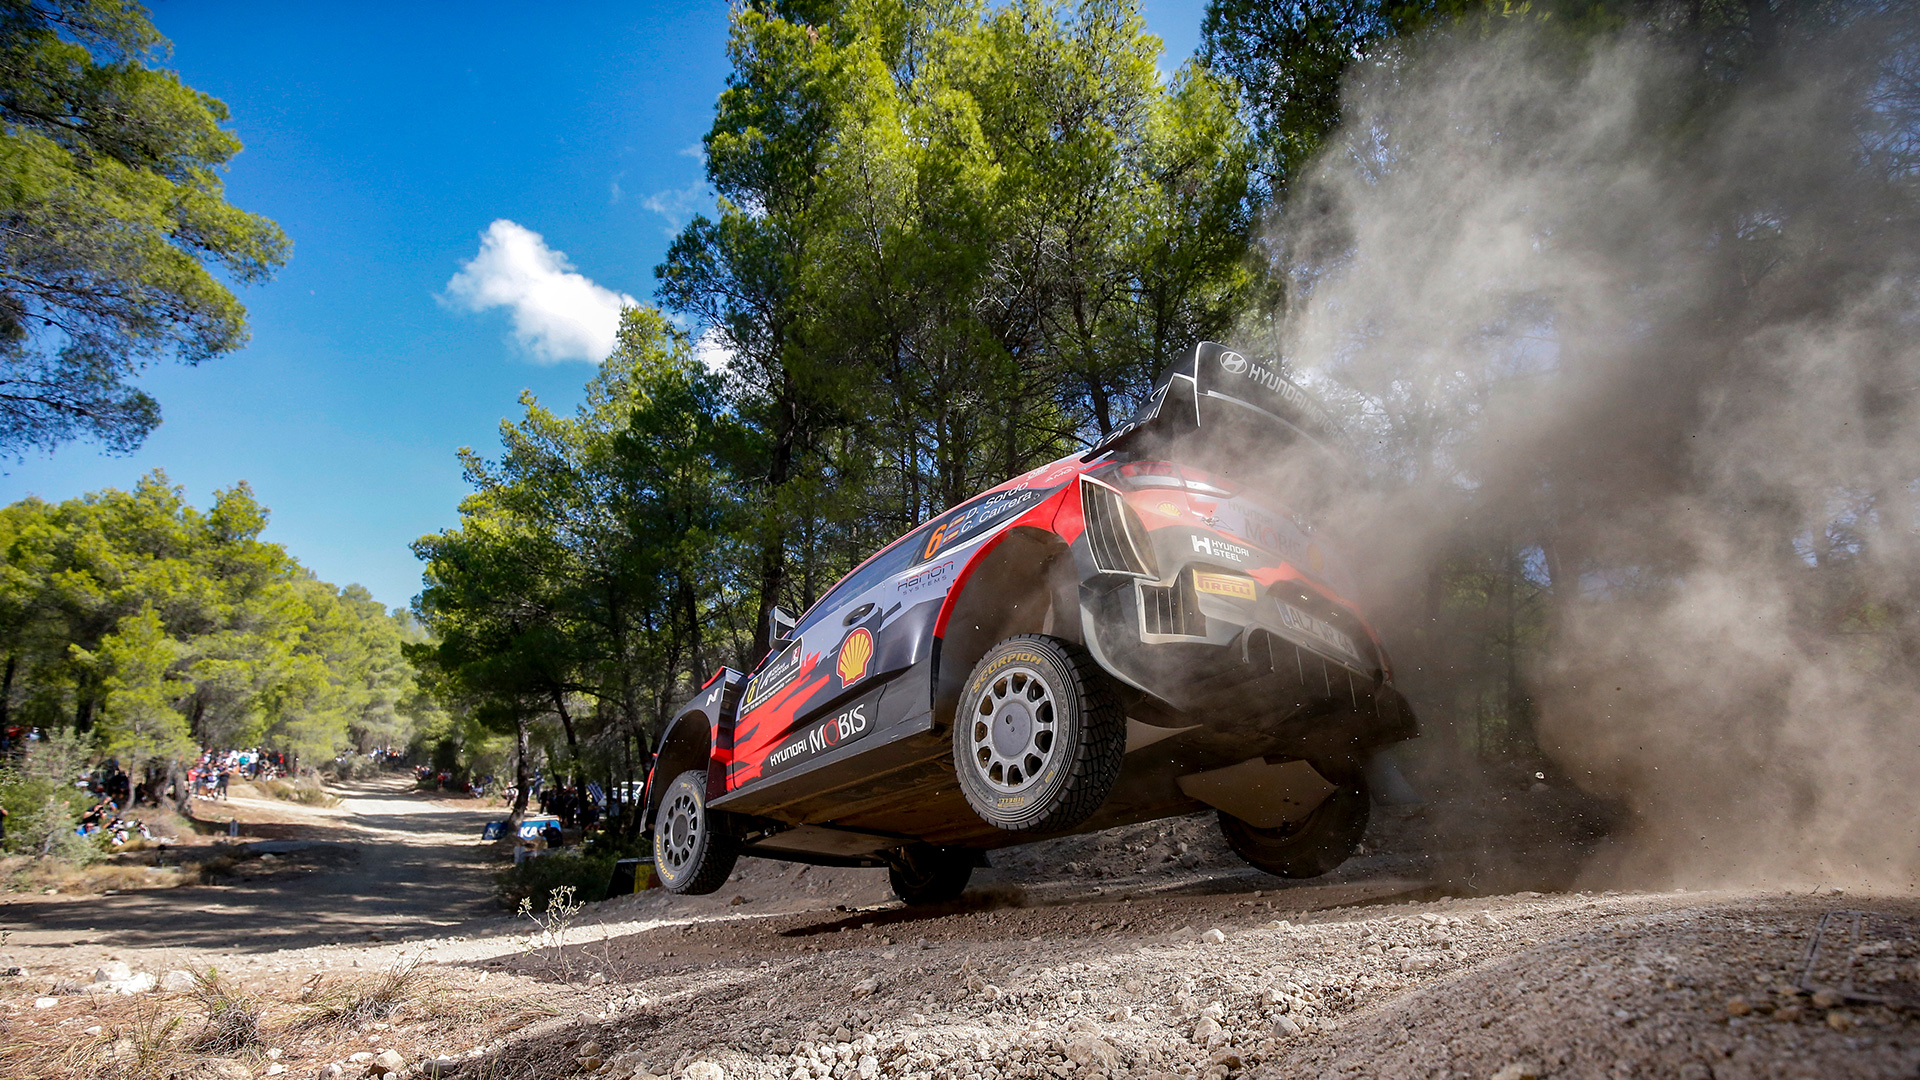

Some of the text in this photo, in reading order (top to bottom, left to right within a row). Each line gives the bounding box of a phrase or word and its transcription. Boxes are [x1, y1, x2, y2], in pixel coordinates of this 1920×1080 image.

[1248, 363, 1307, 410] HYUNDAI
[961, 490, 1032, 534] C. Carrera
[966, 481, 1029, 520] D. Sordo
[924, 523, 947, 559] 6
[1211, 539, 1250, 557] HYUNDAI
[1213, 548, 1242, 563] STEEL
[902, 575, 947, 596] SYSTEMS
[1197, 575, 1251, 596] PIRELLI
[973, 652, 1042, 694] SCORPION
[746, 678, 758, 703] 6
[808, 703, 867, 754] MOBIS
[770, 739, 807, 766] HYUNDAI
